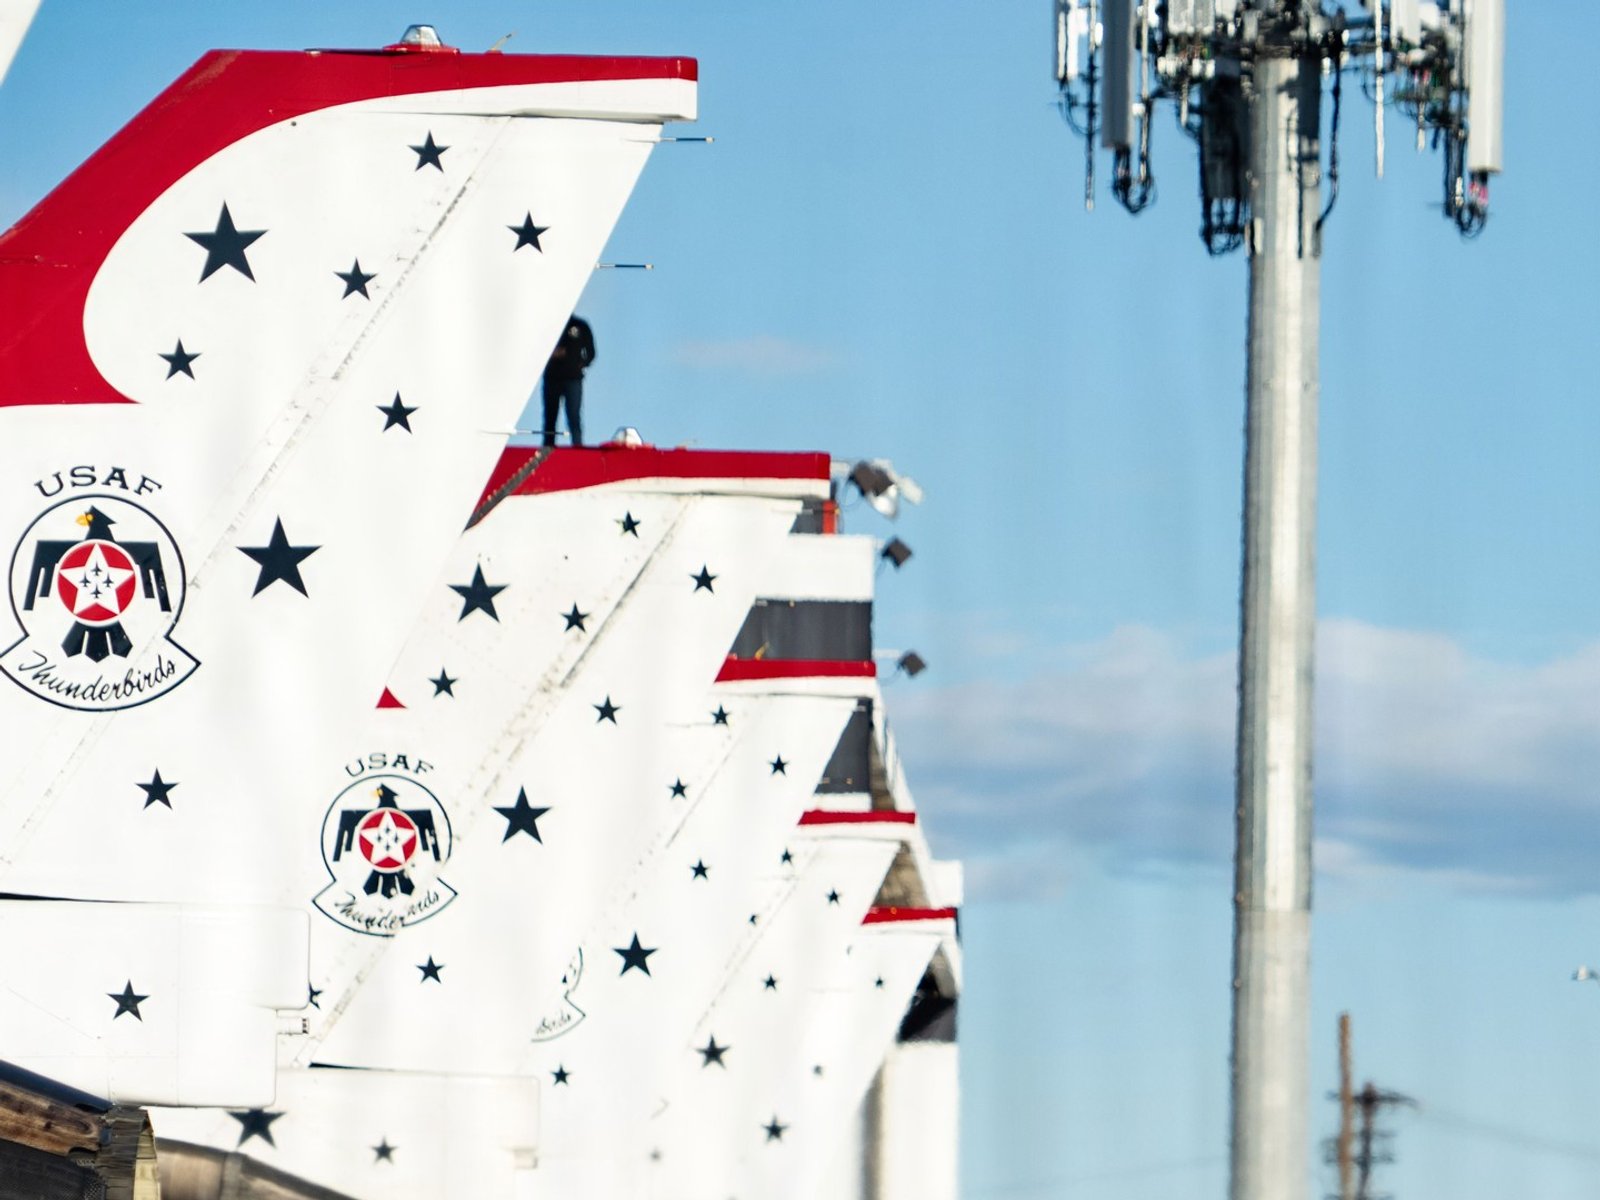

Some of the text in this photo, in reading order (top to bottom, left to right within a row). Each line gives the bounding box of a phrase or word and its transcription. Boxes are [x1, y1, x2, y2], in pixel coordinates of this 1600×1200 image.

[34, 465, 163, 498] USAF
[17, 650, 177, 702] Thunderbirds
[345, 752, 434, 778] USAF
